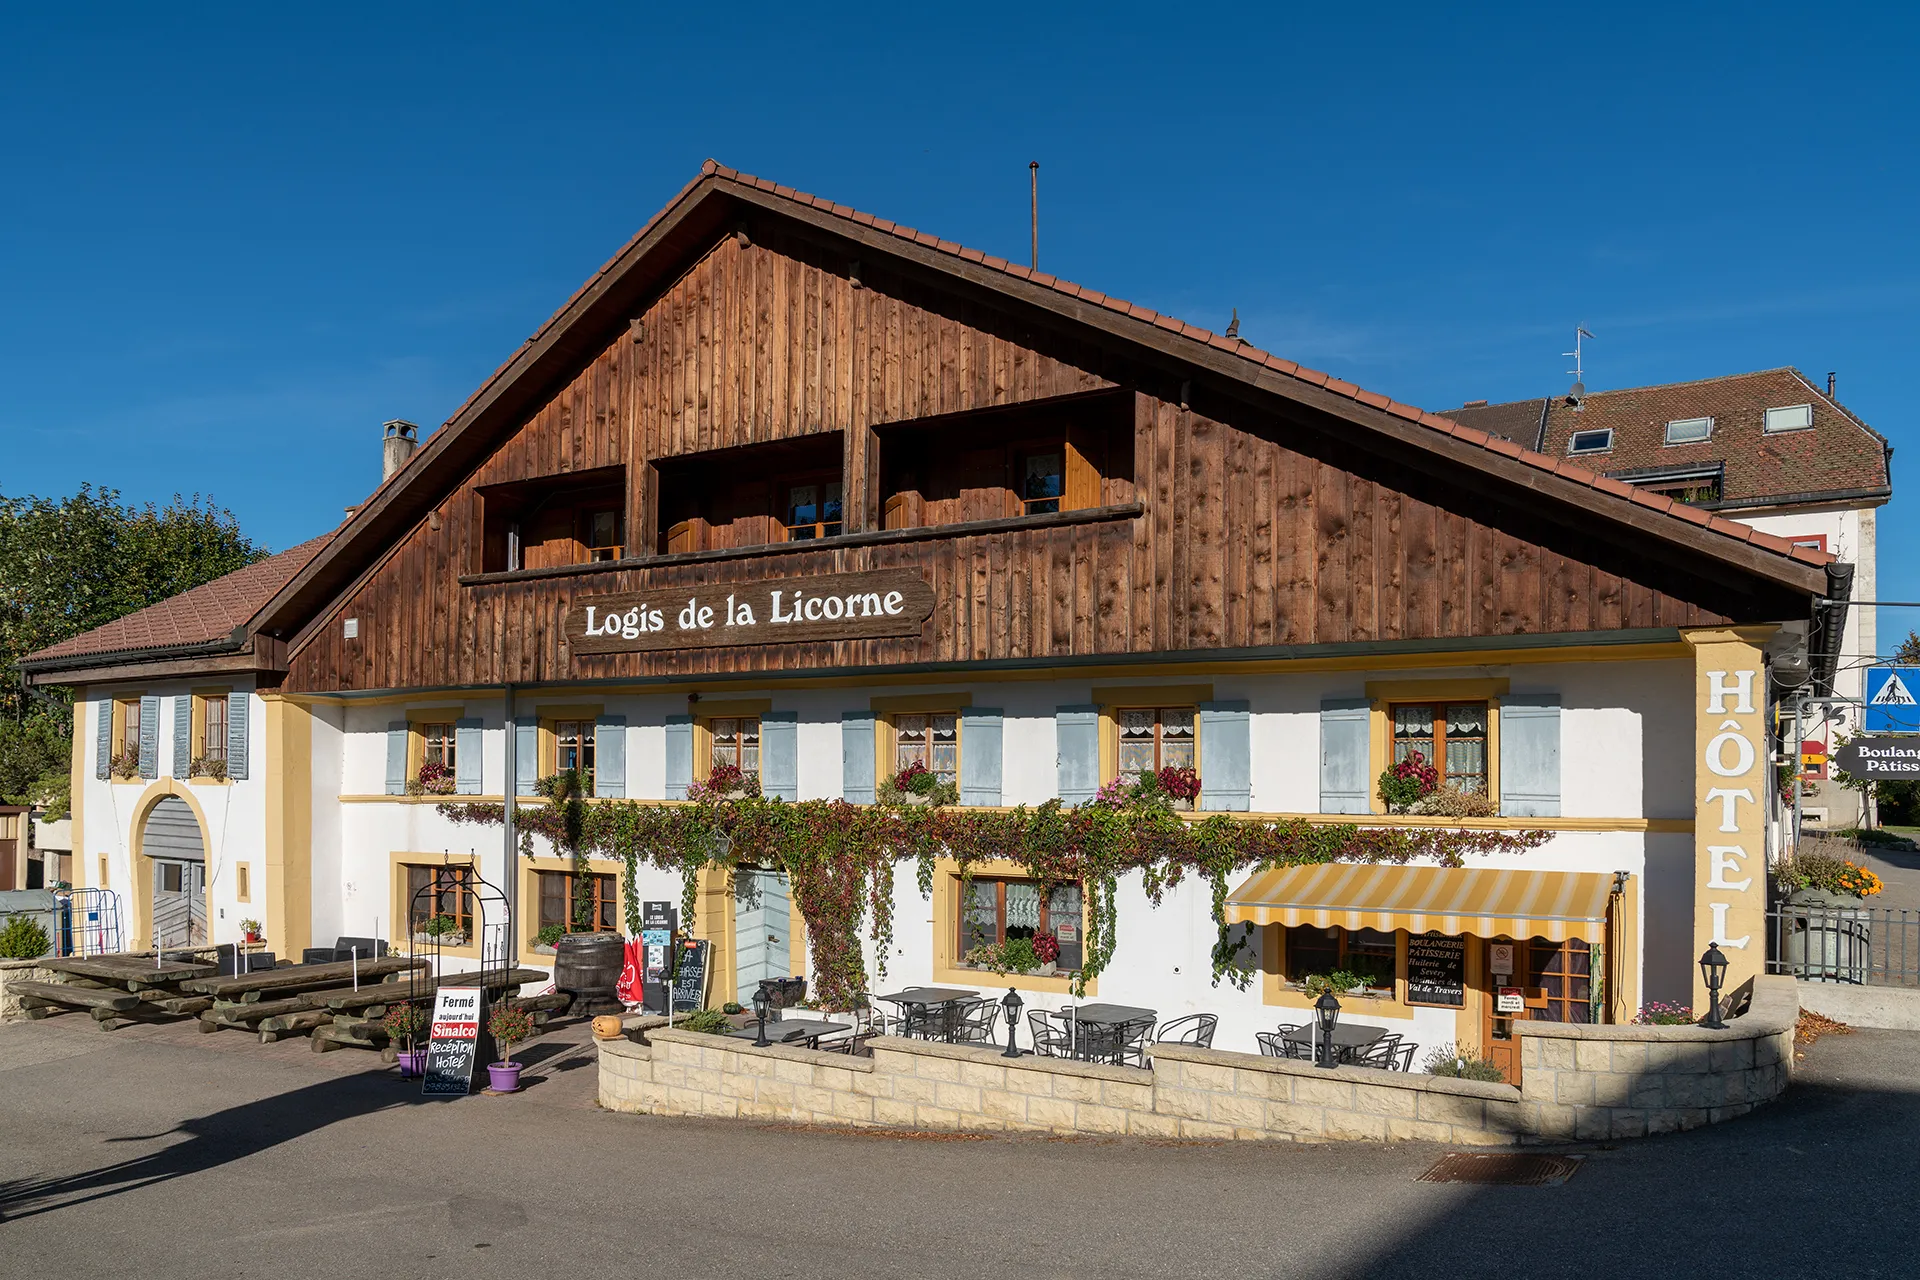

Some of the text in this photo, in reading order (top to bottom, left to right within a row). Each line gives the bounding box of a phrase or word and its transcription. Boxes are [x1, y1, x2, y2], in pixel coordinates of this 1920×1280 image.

[585, 590, 903, 639] Logis de la Licorne
[1866, 760, 1920, 772] Pâtiss
[1705, 670, 1756, 949] HÔTEL
[1409, 939, 1464, 949] BOULANGERIE
[1408, 958, 1440, 967] Huilerie
[681, 979, 697, 988] EST
[1409, 983, 1421, 992] Val
[1434, 985, 1463, 995] Travers
[443, 996, 475, 1007] Fermé
[439, 1013, 475, 1022] aujourd'hui
[433, 1023, 476, 1037] Sinalco
